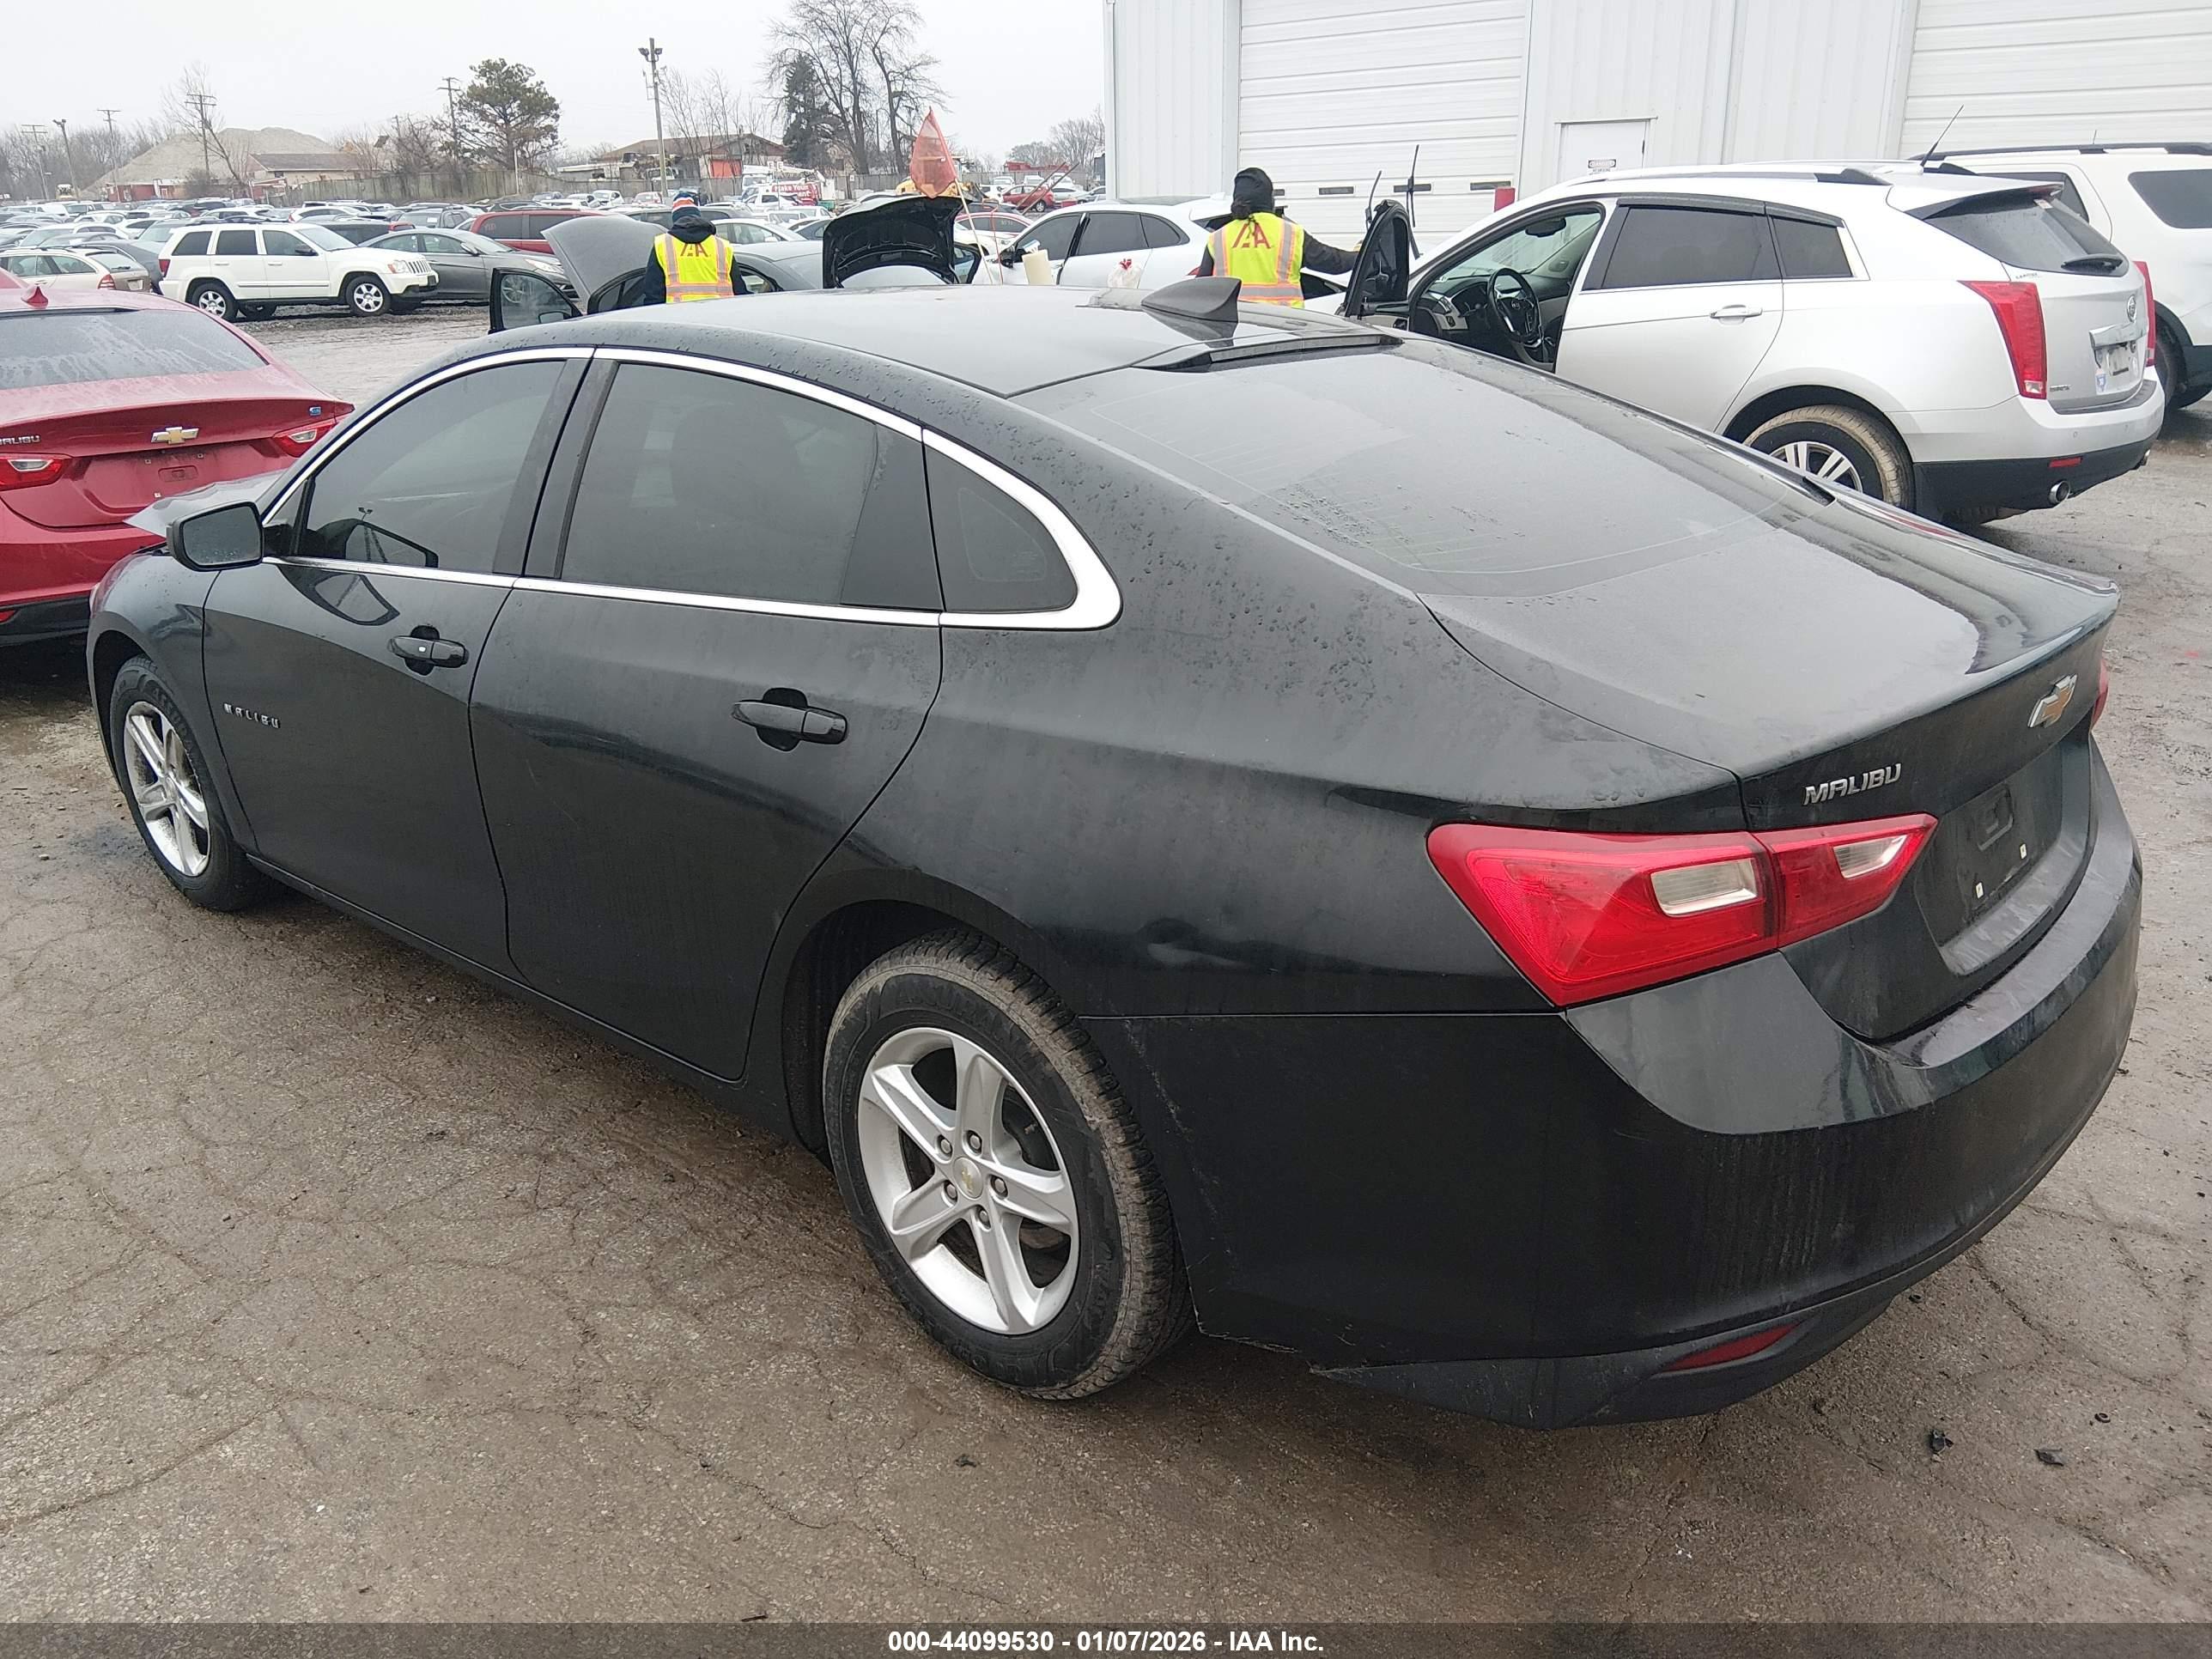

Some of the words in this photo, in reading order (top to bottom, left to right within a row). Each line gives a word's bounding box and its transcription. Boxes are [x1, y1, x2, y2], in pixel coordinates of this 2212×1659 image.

[793, 183, 809, 191] Your
[0, 435, 40, 446] ALIBU
[223, 702, 279, 729] MALIBU
[1802, 763, 1902, 805] MALIBU
